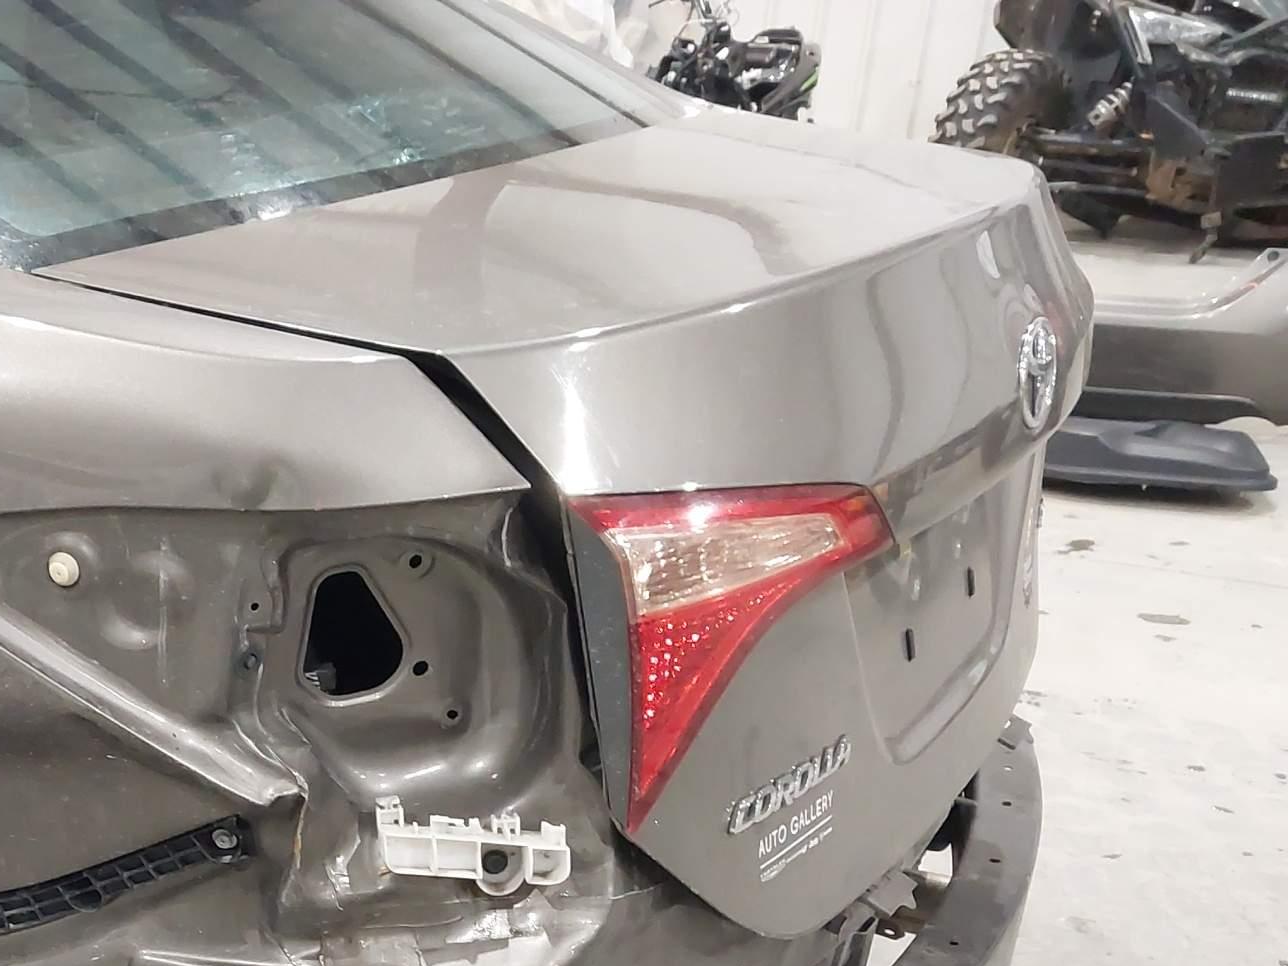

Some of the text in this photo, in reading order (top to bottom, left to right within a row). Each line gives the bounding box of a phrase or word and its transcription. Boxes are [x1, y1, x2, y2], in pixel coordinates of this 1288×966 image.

[726, 734, 851, 834] COROLLA
[758, 824, 787, 858] AUTO
[790, 790, 833, 833] GALLERY
